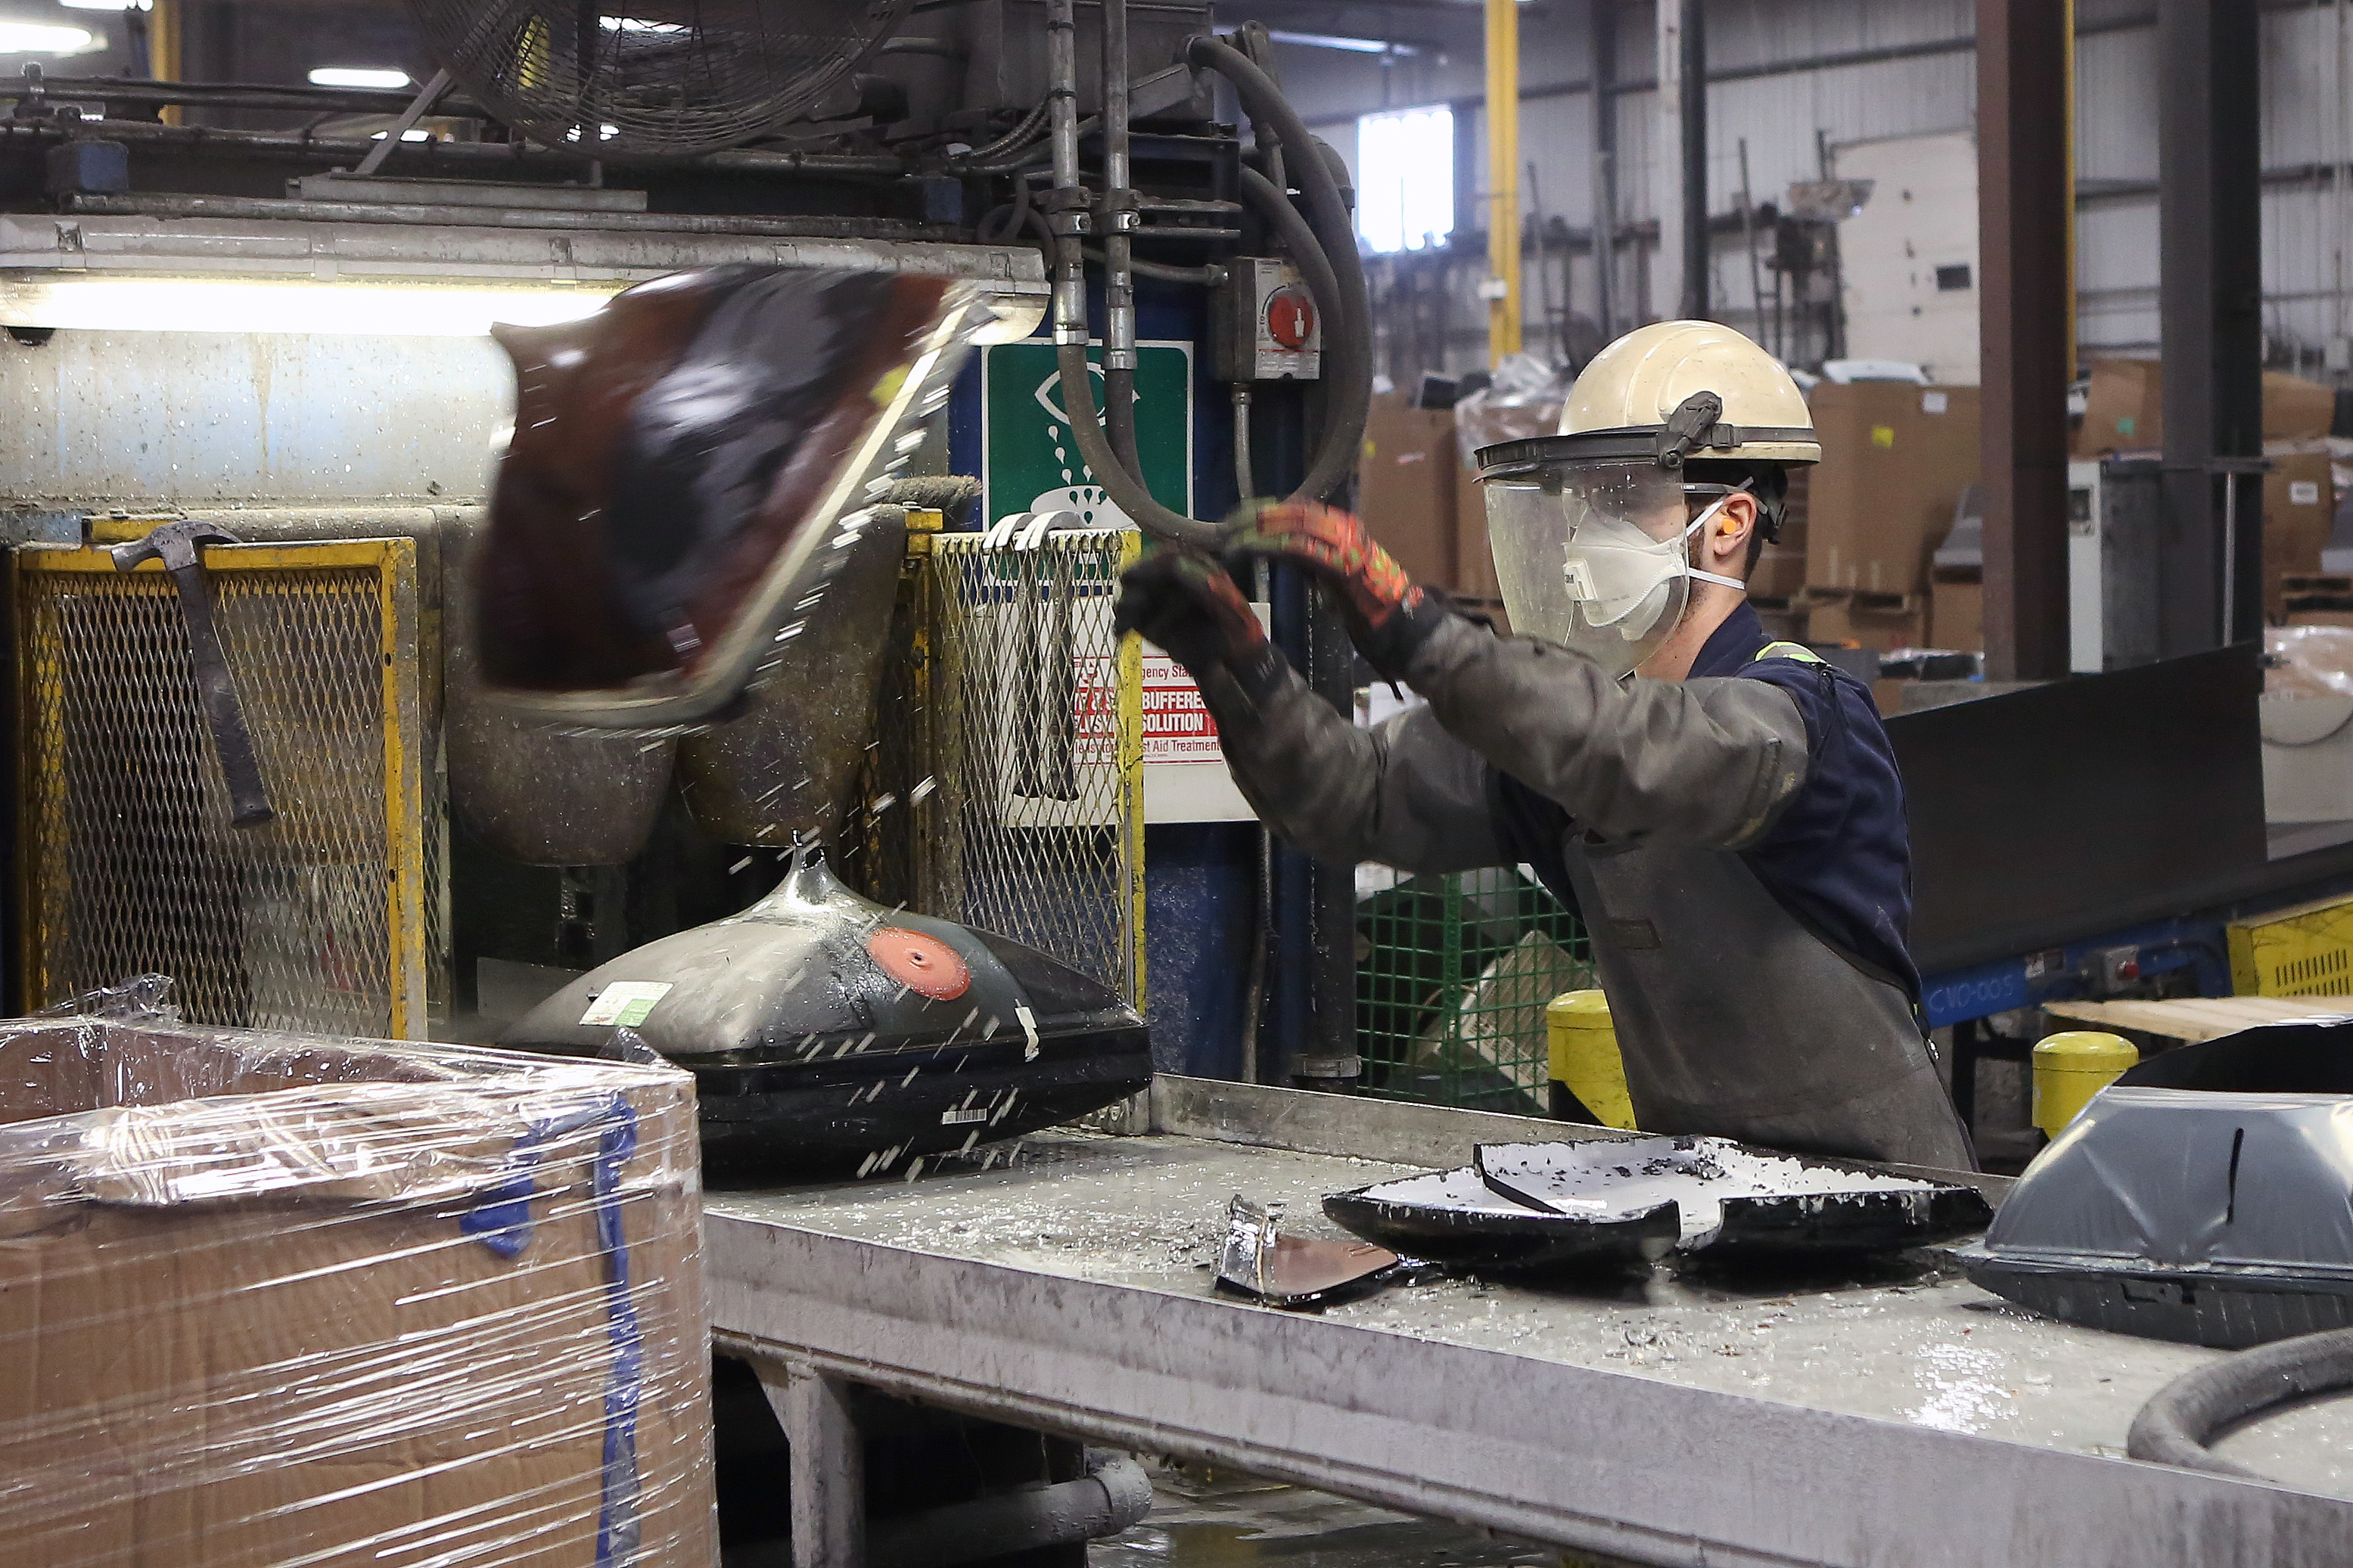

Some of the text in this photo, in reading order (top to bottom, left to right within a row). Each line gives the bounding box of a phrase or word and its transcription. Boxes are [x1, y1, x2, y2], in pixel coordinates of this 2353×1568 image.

[1142, 665, 1191, 680] gency Sta
[1142, 713, 1204, 732] SOLUTION
[1153, 739, 1169, 752] Aid
